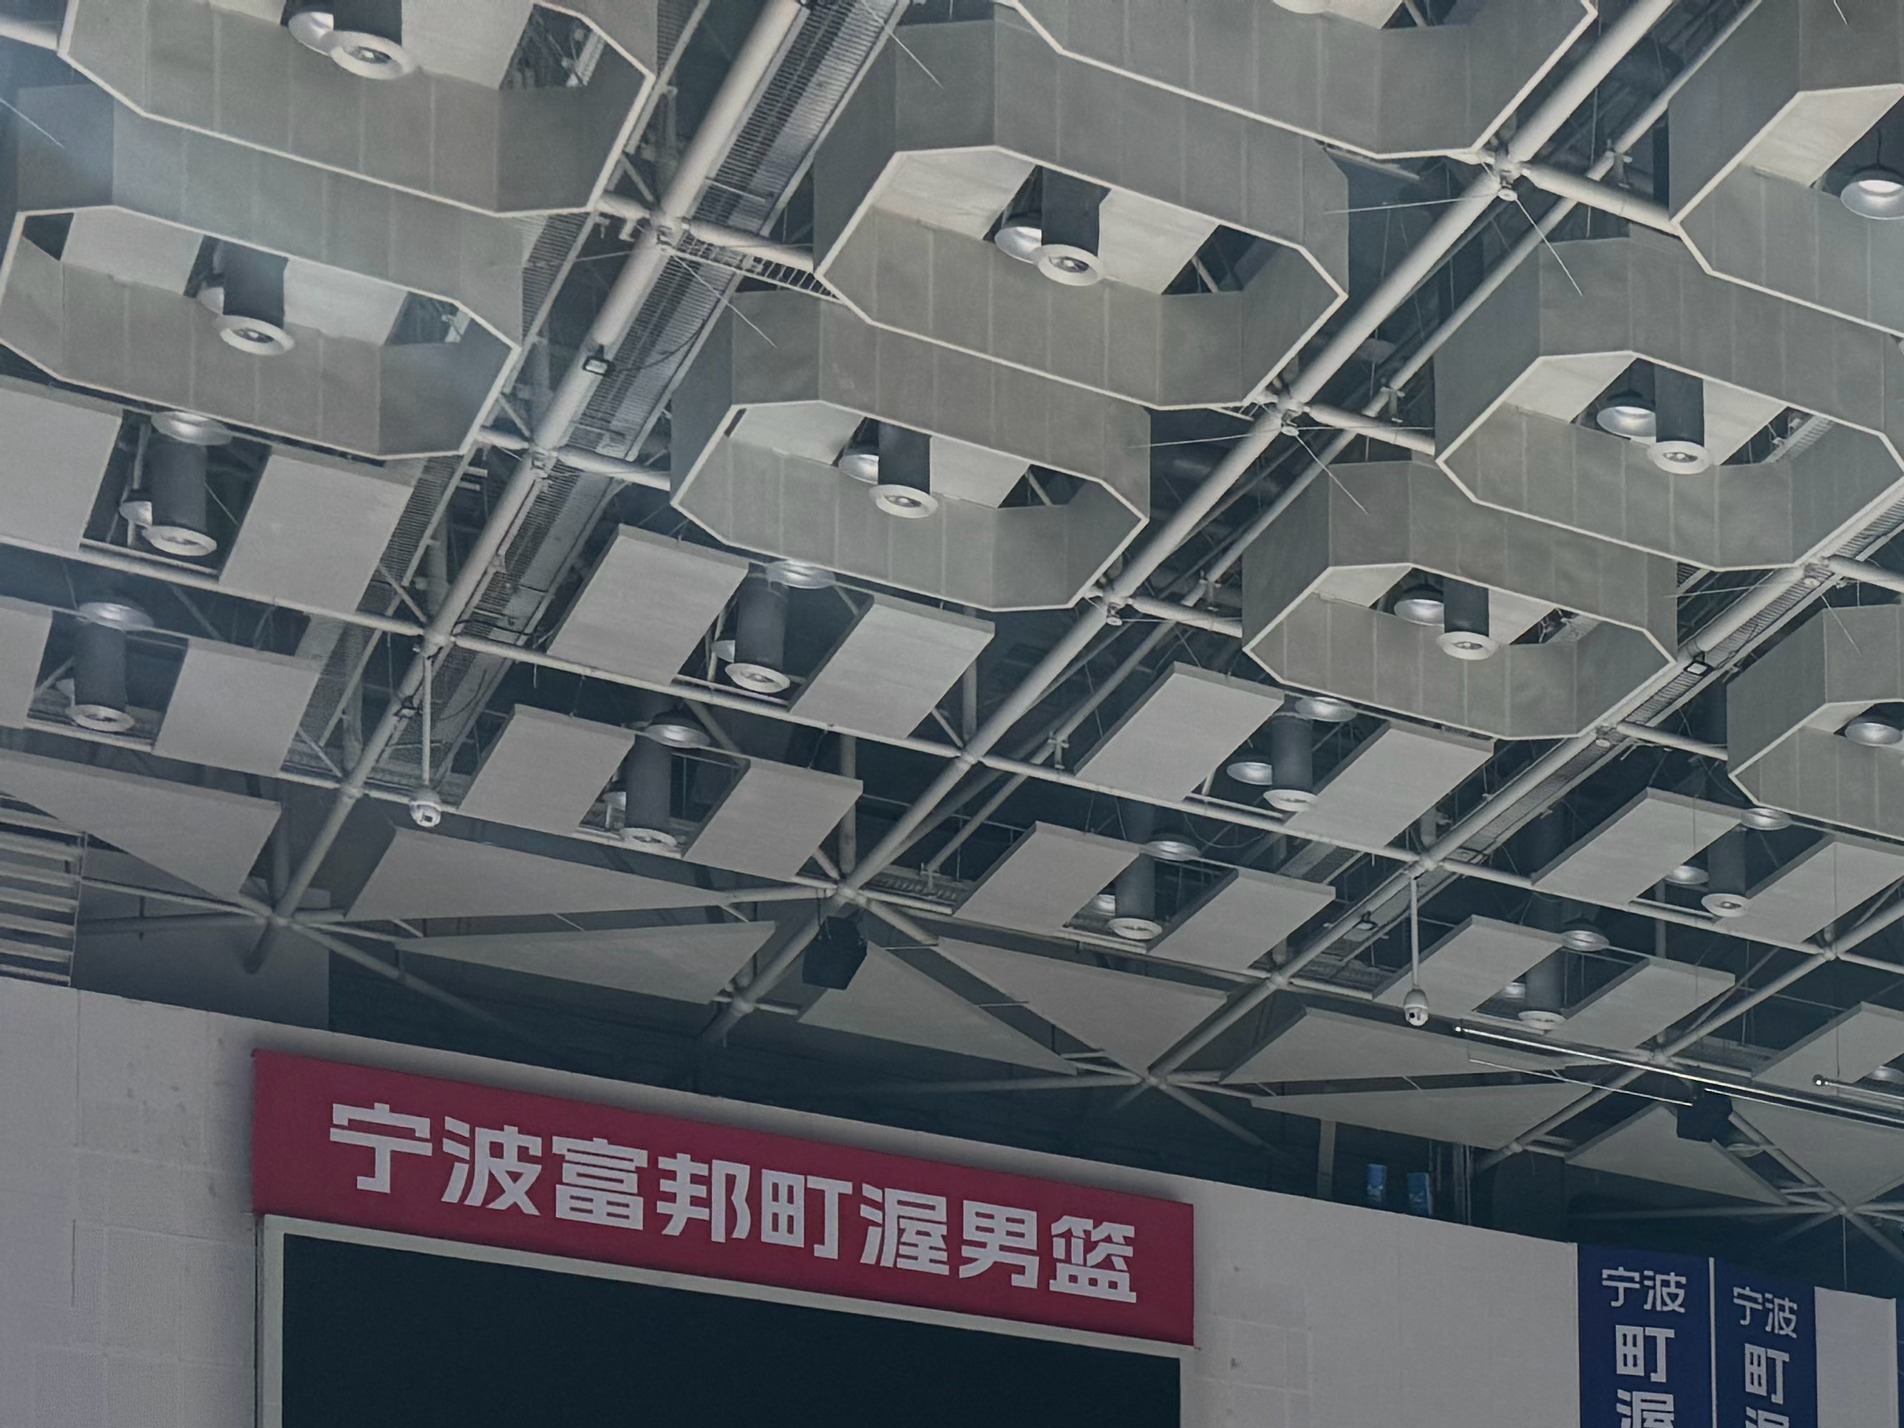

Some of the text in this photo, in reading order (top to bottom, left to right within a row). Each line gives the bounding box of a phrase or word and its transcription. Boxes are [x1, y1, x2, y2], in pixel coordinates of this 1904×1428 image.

[329, 1103, 1136, 1303] 宁波富邦町渥男篮
[1601, 1265, 1687, 1315] 宁波
[1732, 1285, 1799, 1340] 宁波
